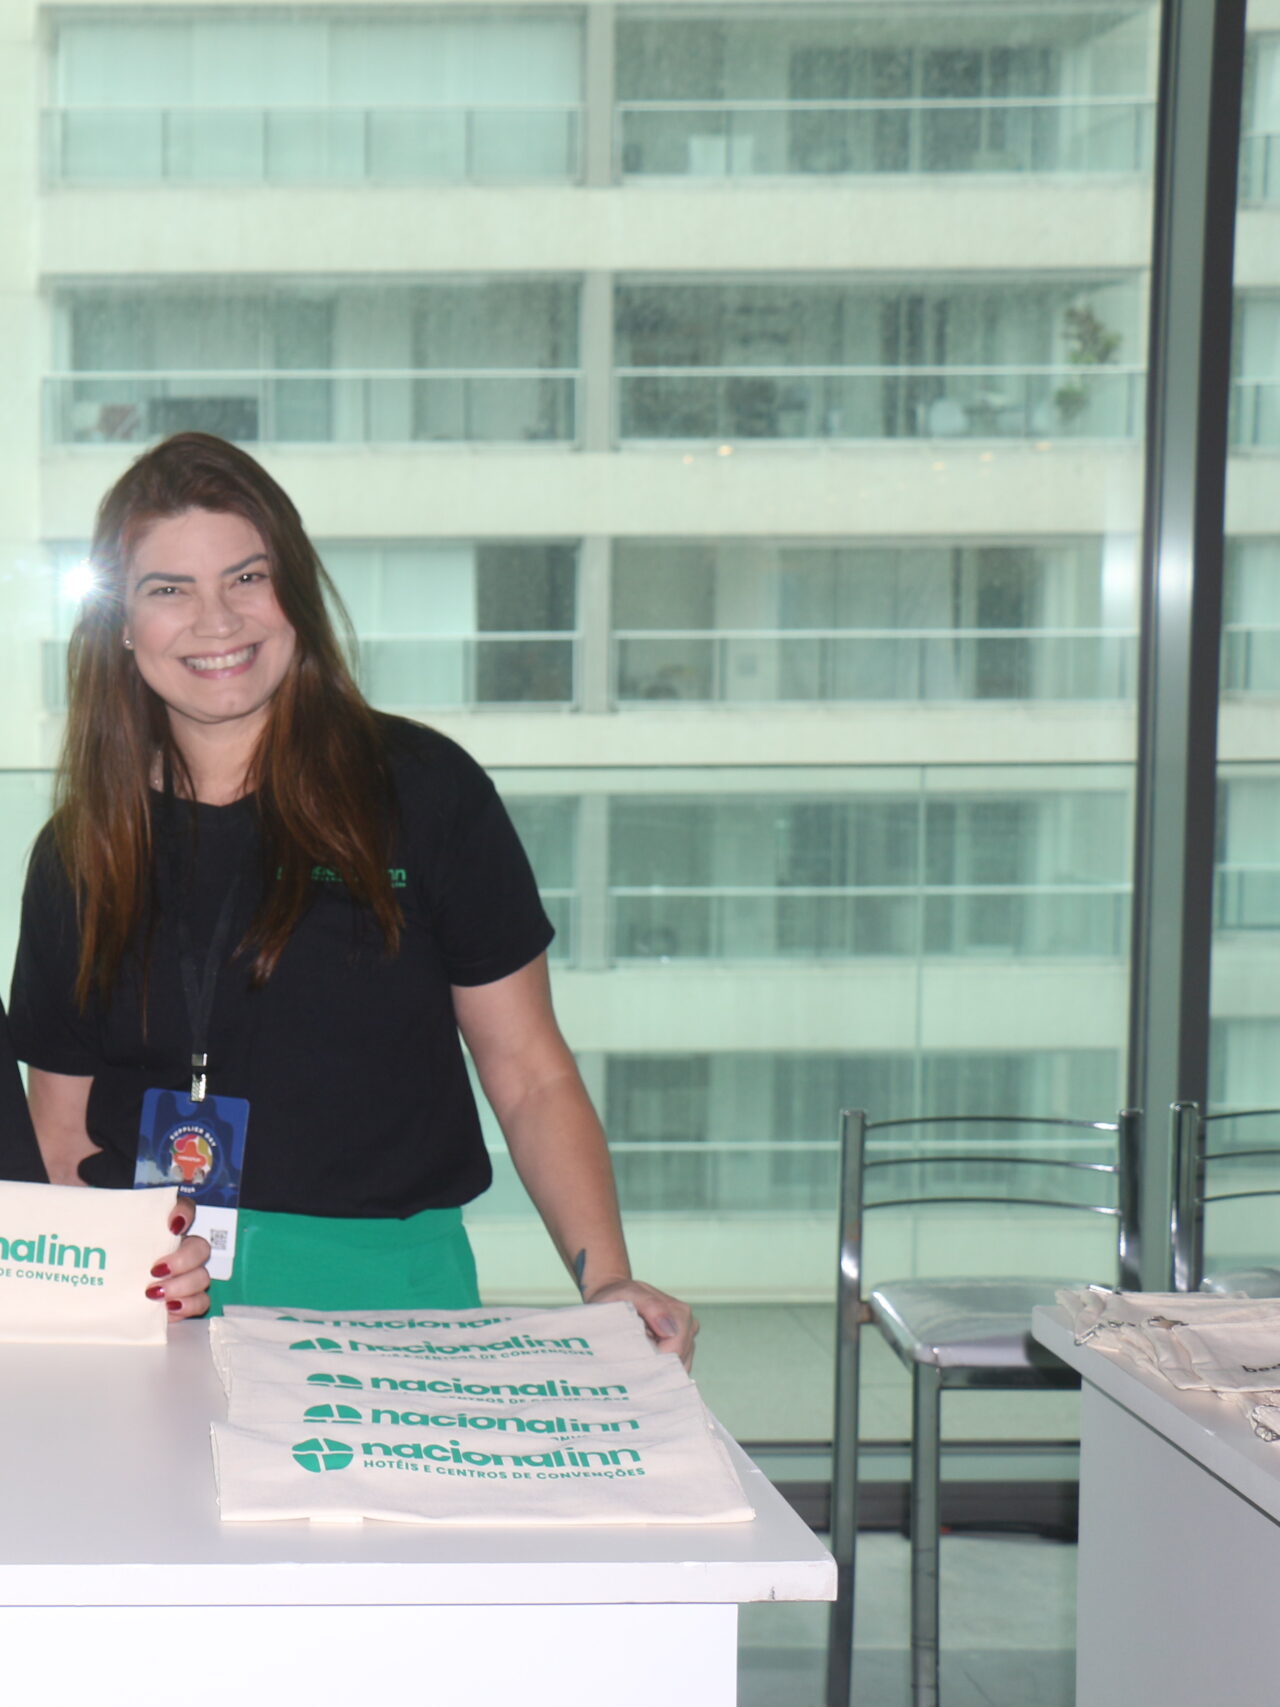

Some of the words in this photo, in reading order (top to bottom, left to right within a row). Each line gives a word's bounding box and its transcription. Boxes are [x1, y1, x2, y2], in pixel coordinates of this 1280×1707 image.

[16, 1269, 105, 1287] CONVENÇÕES
[361, 1439, 641, 1468] nacionalinn
[364, 1459, 419, 1472] HOTÉIS
[423, 1465, 431, 1473] E
[436, 1466, 507, 1480] CENTROS
[512, 1471, 532, 1480] DE
[536, 1467, 646, 1480] CONVENÇÕES
